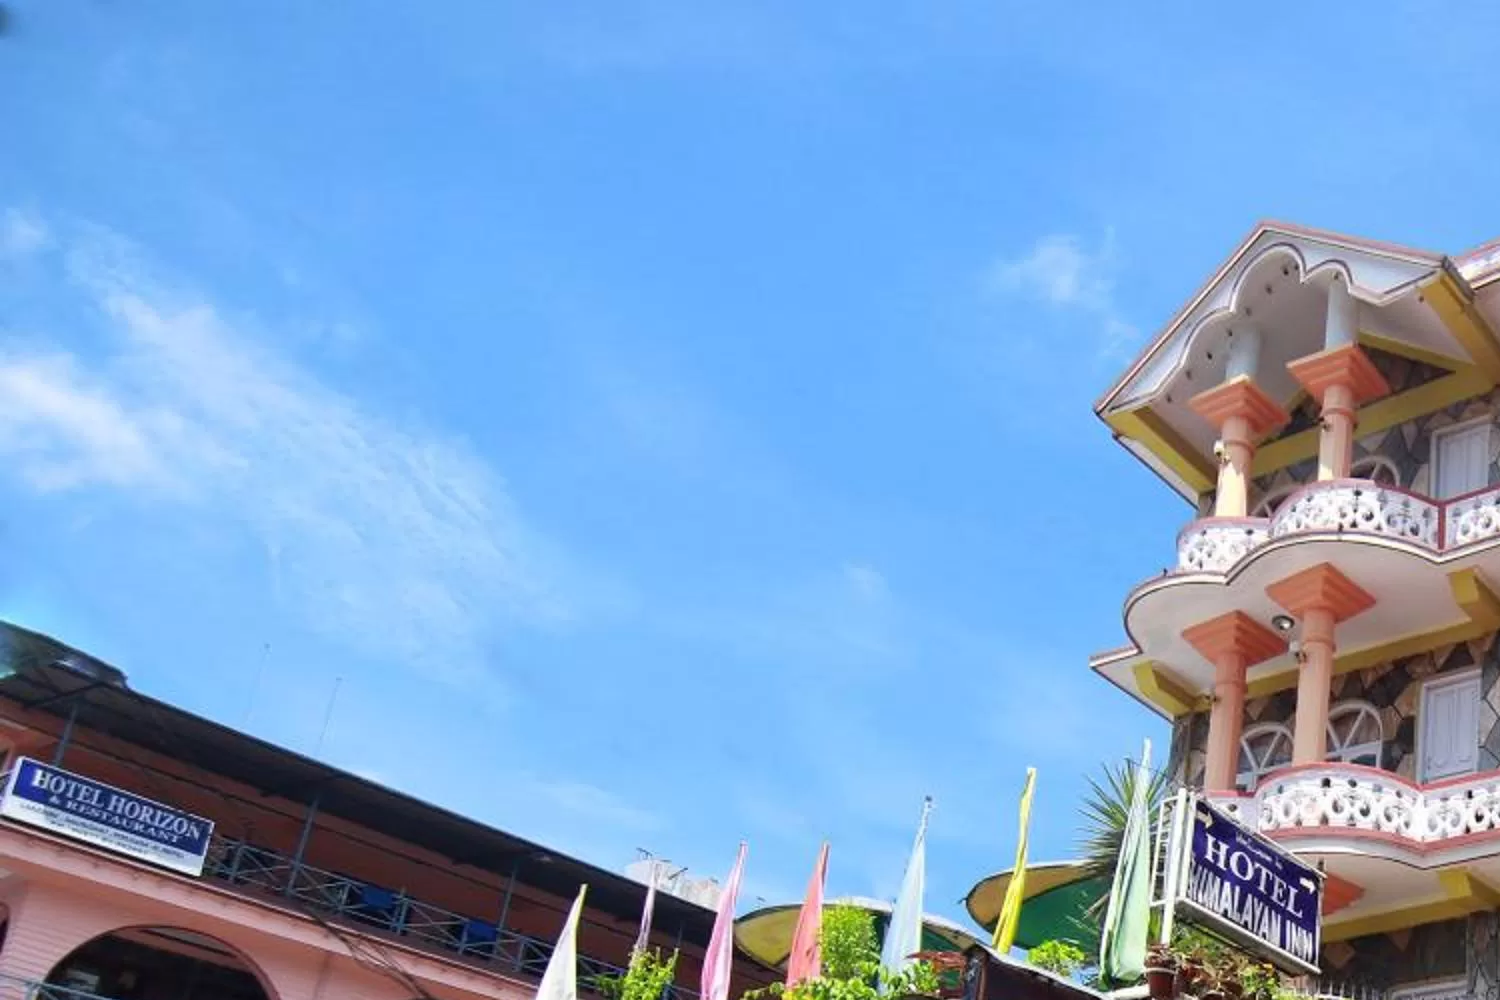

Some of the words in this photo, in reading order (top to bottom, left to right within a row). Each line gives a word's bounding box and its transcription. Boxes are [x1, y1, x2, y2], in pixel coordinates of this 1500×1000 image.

[32, 768, 104, 808] HOTEL
[107, 794, 202, 841] HORIZON
[66, 801, 184, 843] RESTAURANT
[1189, 859, 1281, 948] HIMALAYAN
[1285, 919, 1313, 962] INN
[1205, 833, 1303, 919] HOTEL
